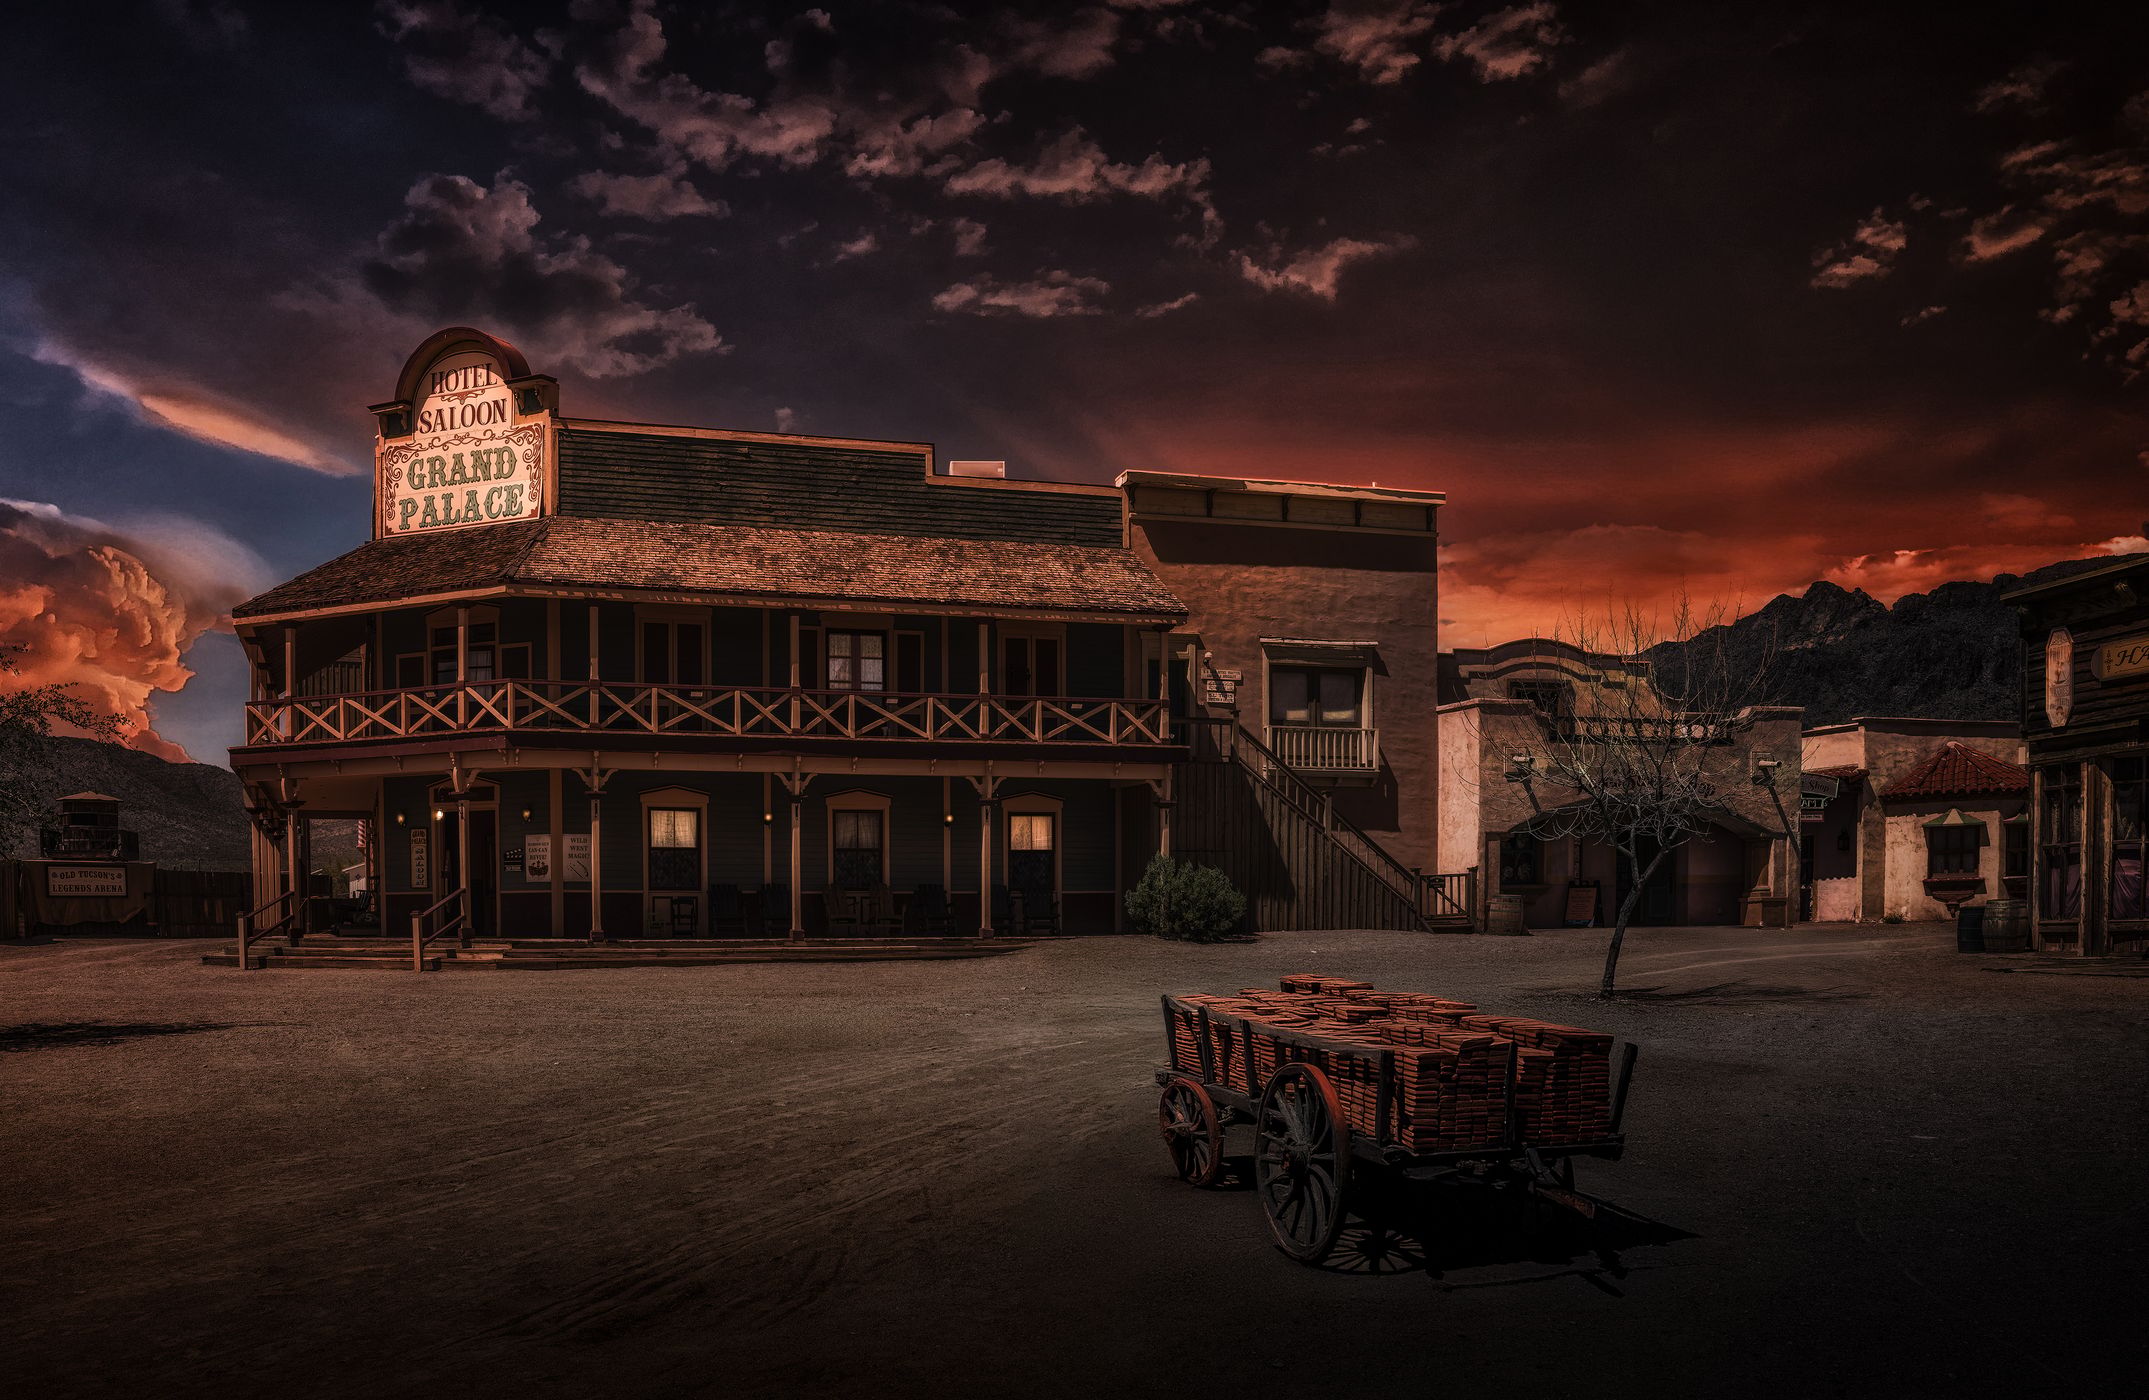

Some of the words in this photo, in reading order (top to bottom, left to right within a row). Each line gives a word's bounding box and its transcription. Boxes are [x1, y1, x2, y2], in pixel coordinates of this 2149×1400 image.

[431, 363, 497, 395] HOTEL
[418, 398, 507, 434] SALOON
[406, 445, 517, 490] GRAND
[398, 484, 524, 530] PALACE
[1808, 780, 1830, 792] Shop
[52, 884, 92, 892] LEGENDS
[94, 884, 123, 892] ARENA
[60, 871, 76, 879] OLD
